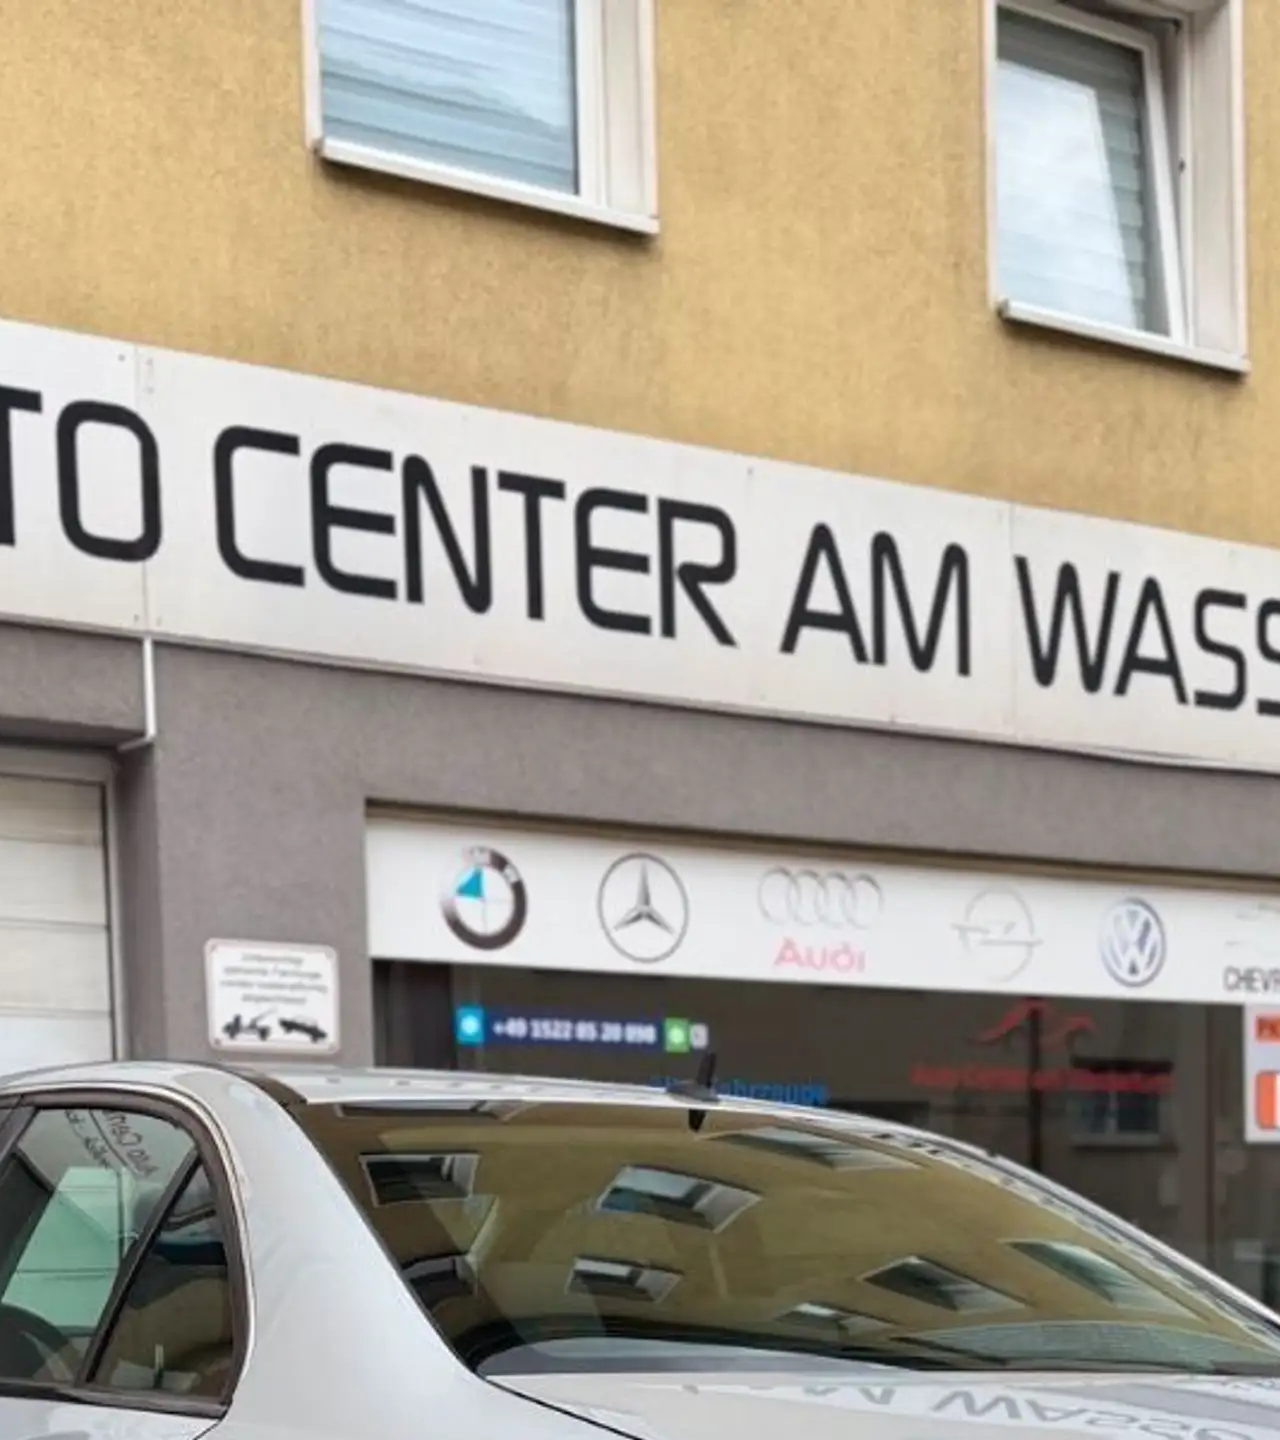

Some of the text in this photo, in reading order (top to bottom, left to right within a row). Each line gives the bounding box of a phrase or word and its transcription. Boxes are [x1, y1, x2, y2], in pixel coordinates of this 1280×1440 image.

[213, 425, 737, 647] CENTER
[780, 522, 970, 677] AM
[773, 936, 866, 973] Audi
